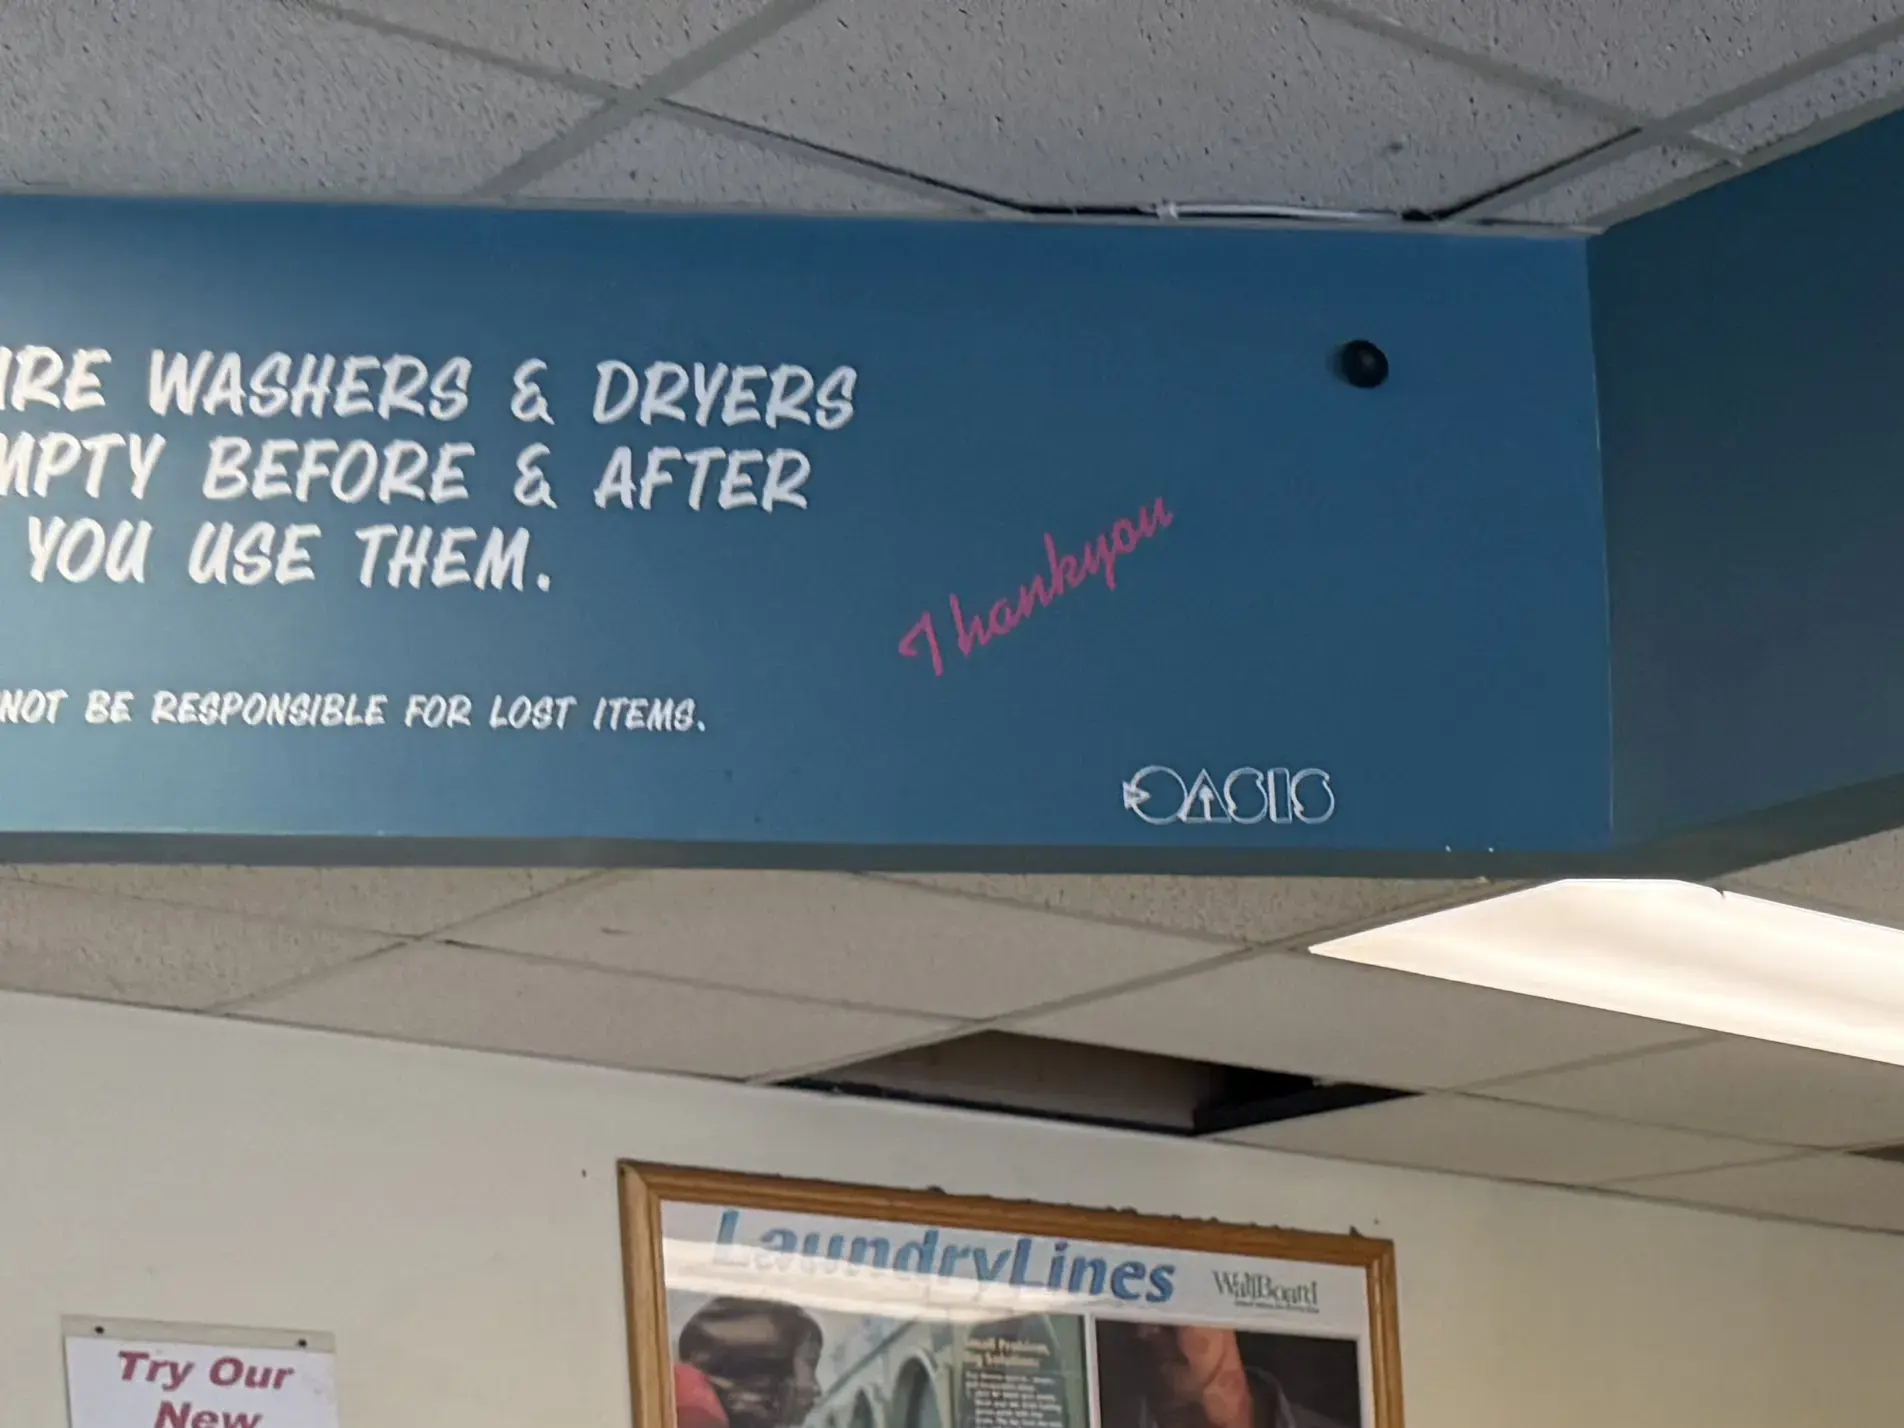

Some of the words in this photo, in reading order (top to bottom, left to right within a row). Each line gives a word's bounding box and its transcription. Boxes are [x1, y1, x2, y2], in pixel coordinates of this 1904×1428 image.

[147, 349, 474, 422] WASHERS
[511, 359, 556, 426] &
[592, 361, 859, 431] DRYERS
[201, 436, 476, 505] BEFORE
[513, 444, 559, 510] &
[593, 447, 812, 514] AFTER
[28, 516, 154, 584] YOU
[187, 522, 323, 587] USE
[355, 524, 552, 593] THEM.
[0, 688, 70, 725] NOT
[84, 689, 136, 726] BE
[150, 690, 389, 728] RESPONSIBLE
[404, 694, 473, 730] FOR
[489, 695, 578, 731] LOST
[593, 697, 708, 734] ITEMS.
[1122, 764, 1337, 827] OASIS
[714, 1208, 1177, 1306] LaundryLines
[118, 1350, 195, 1392] Try
[208, 1355, 295, 1391] Our
